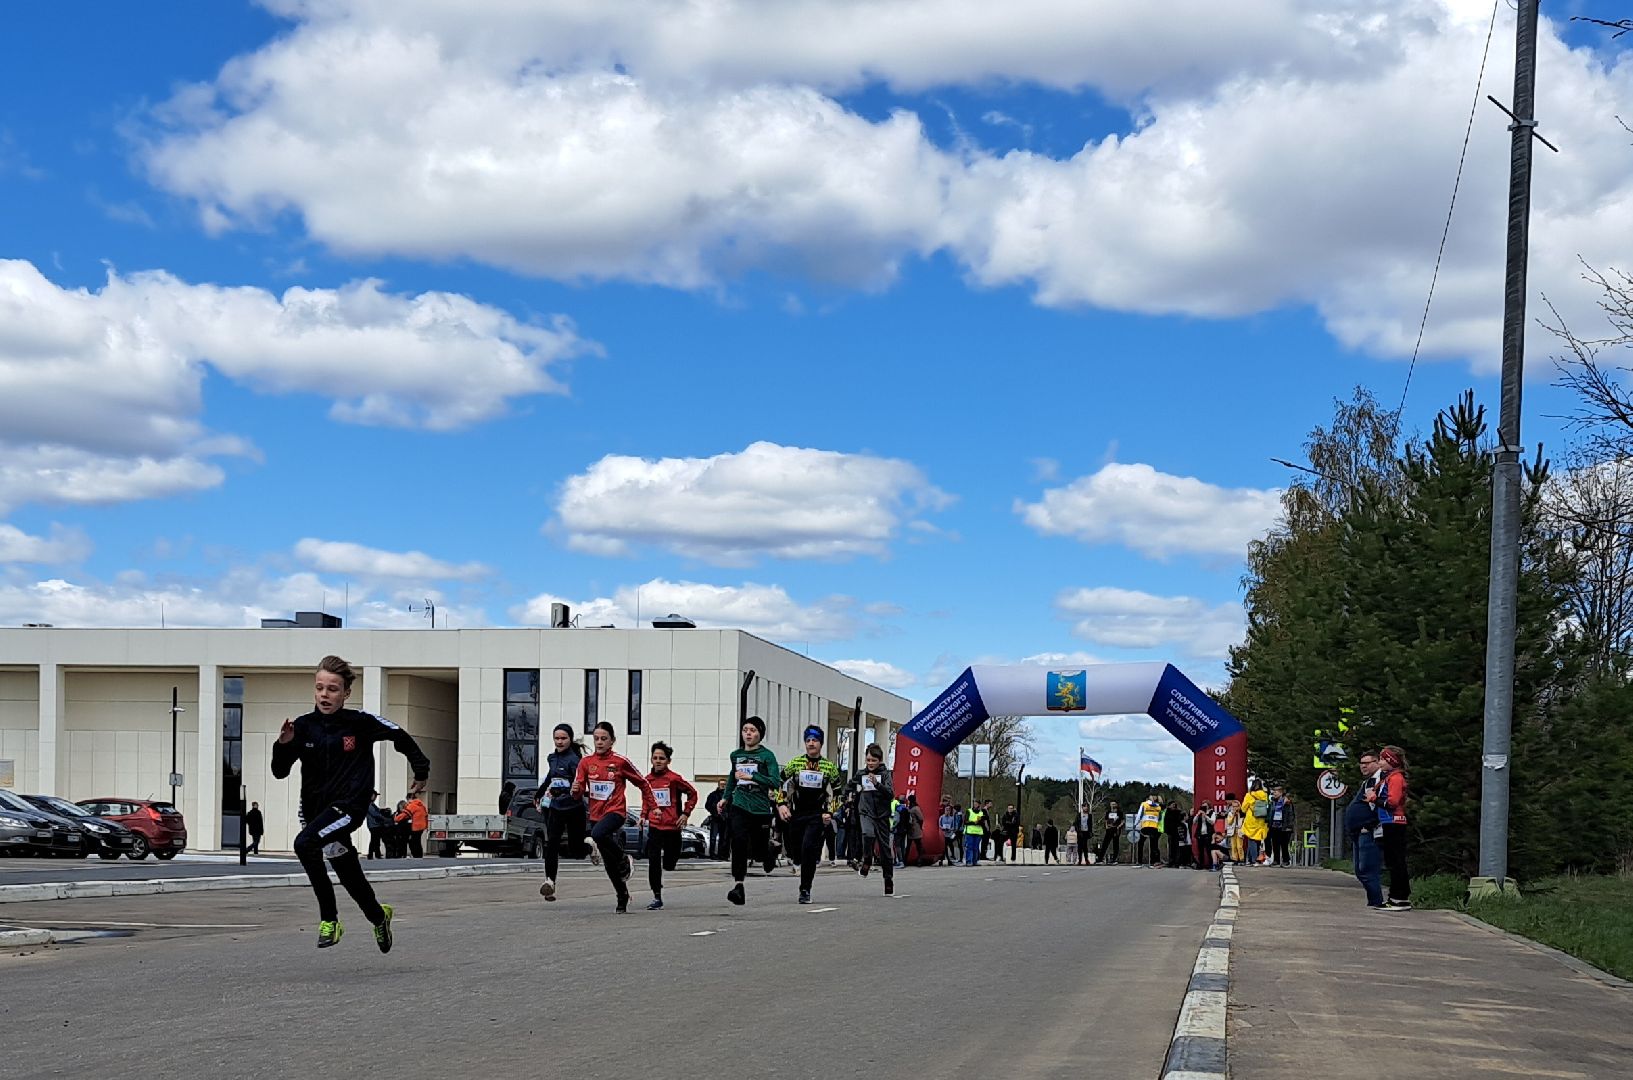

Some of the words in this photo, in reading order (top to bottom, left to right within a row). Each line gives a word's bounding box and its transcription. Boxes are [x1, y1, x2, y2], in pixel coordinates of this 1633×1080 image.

[912, 680, 969, 732] АДМИНИСТРАЦИЯ
[923, 694, 967, 733] ГОРОДСКОГО
[930, 701, 972, 738] ПОСЕЛЕНИЯ
[1165, 707, 1197, 736] ТУЧКОВО
[1168, 698, 1208, 733] КОМПЛЕКС
[1170, 688, 1220, 730] СПОРТИВНЫЙ
[940, 713, 973, 740] ТУЧКОВО
[905, 746, 922, 800] ФИНИ
[1324, 775, 1341, 790] 20
